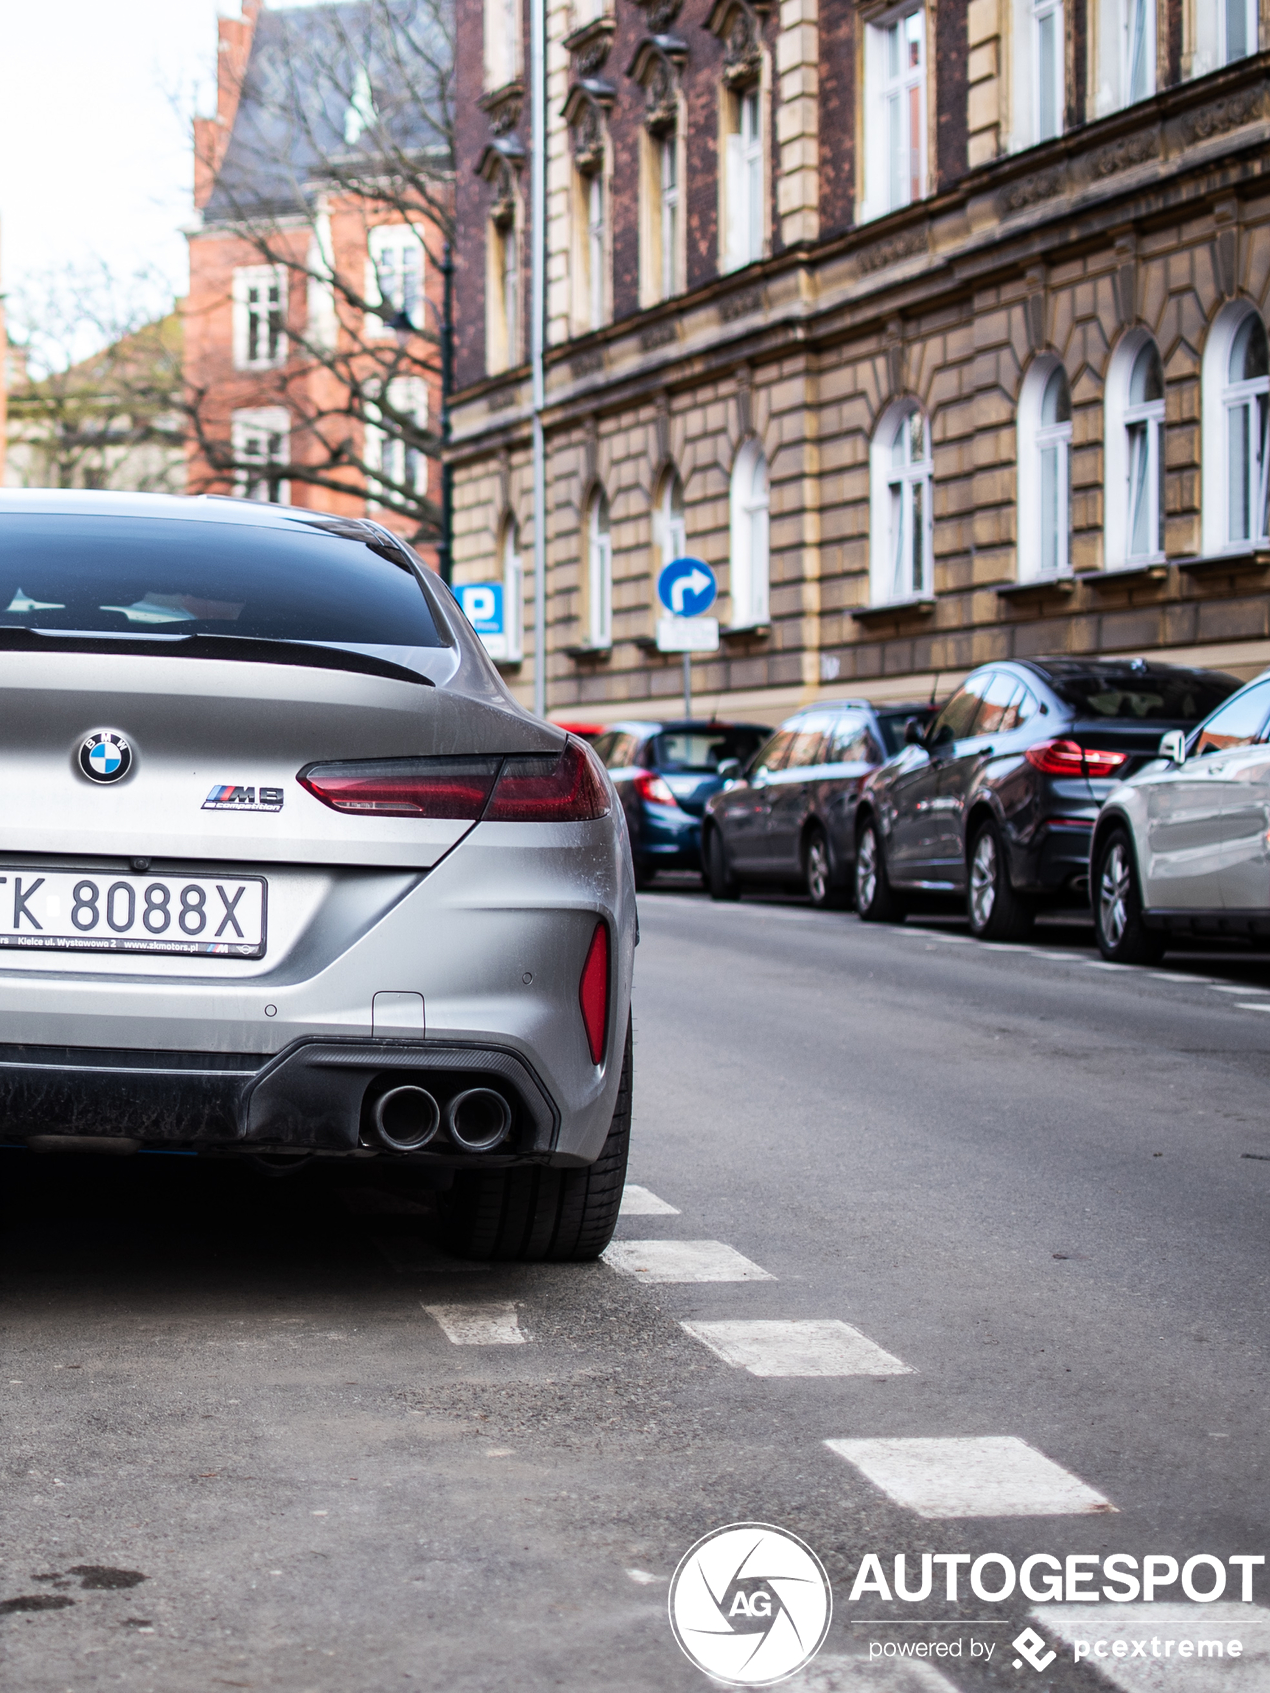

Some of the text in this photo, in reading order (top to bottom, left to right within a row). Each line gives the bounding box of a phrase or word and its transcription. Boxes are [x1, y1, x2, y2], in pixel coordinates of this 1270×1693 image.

[463, 587, 495, 629] P
[85, 732, 128, 751] BMW
[227, 786, 284, 805] M8
[215, 802, 281, 811] competition
[70, 879, 246, 938] 8088X
[17, 936, 44, 946] Kielce
[45, 938, 55, 946] ul.
[110, 939, 117, 948] 2
[124, 941, 199, 952] www.zkmotors.pl
